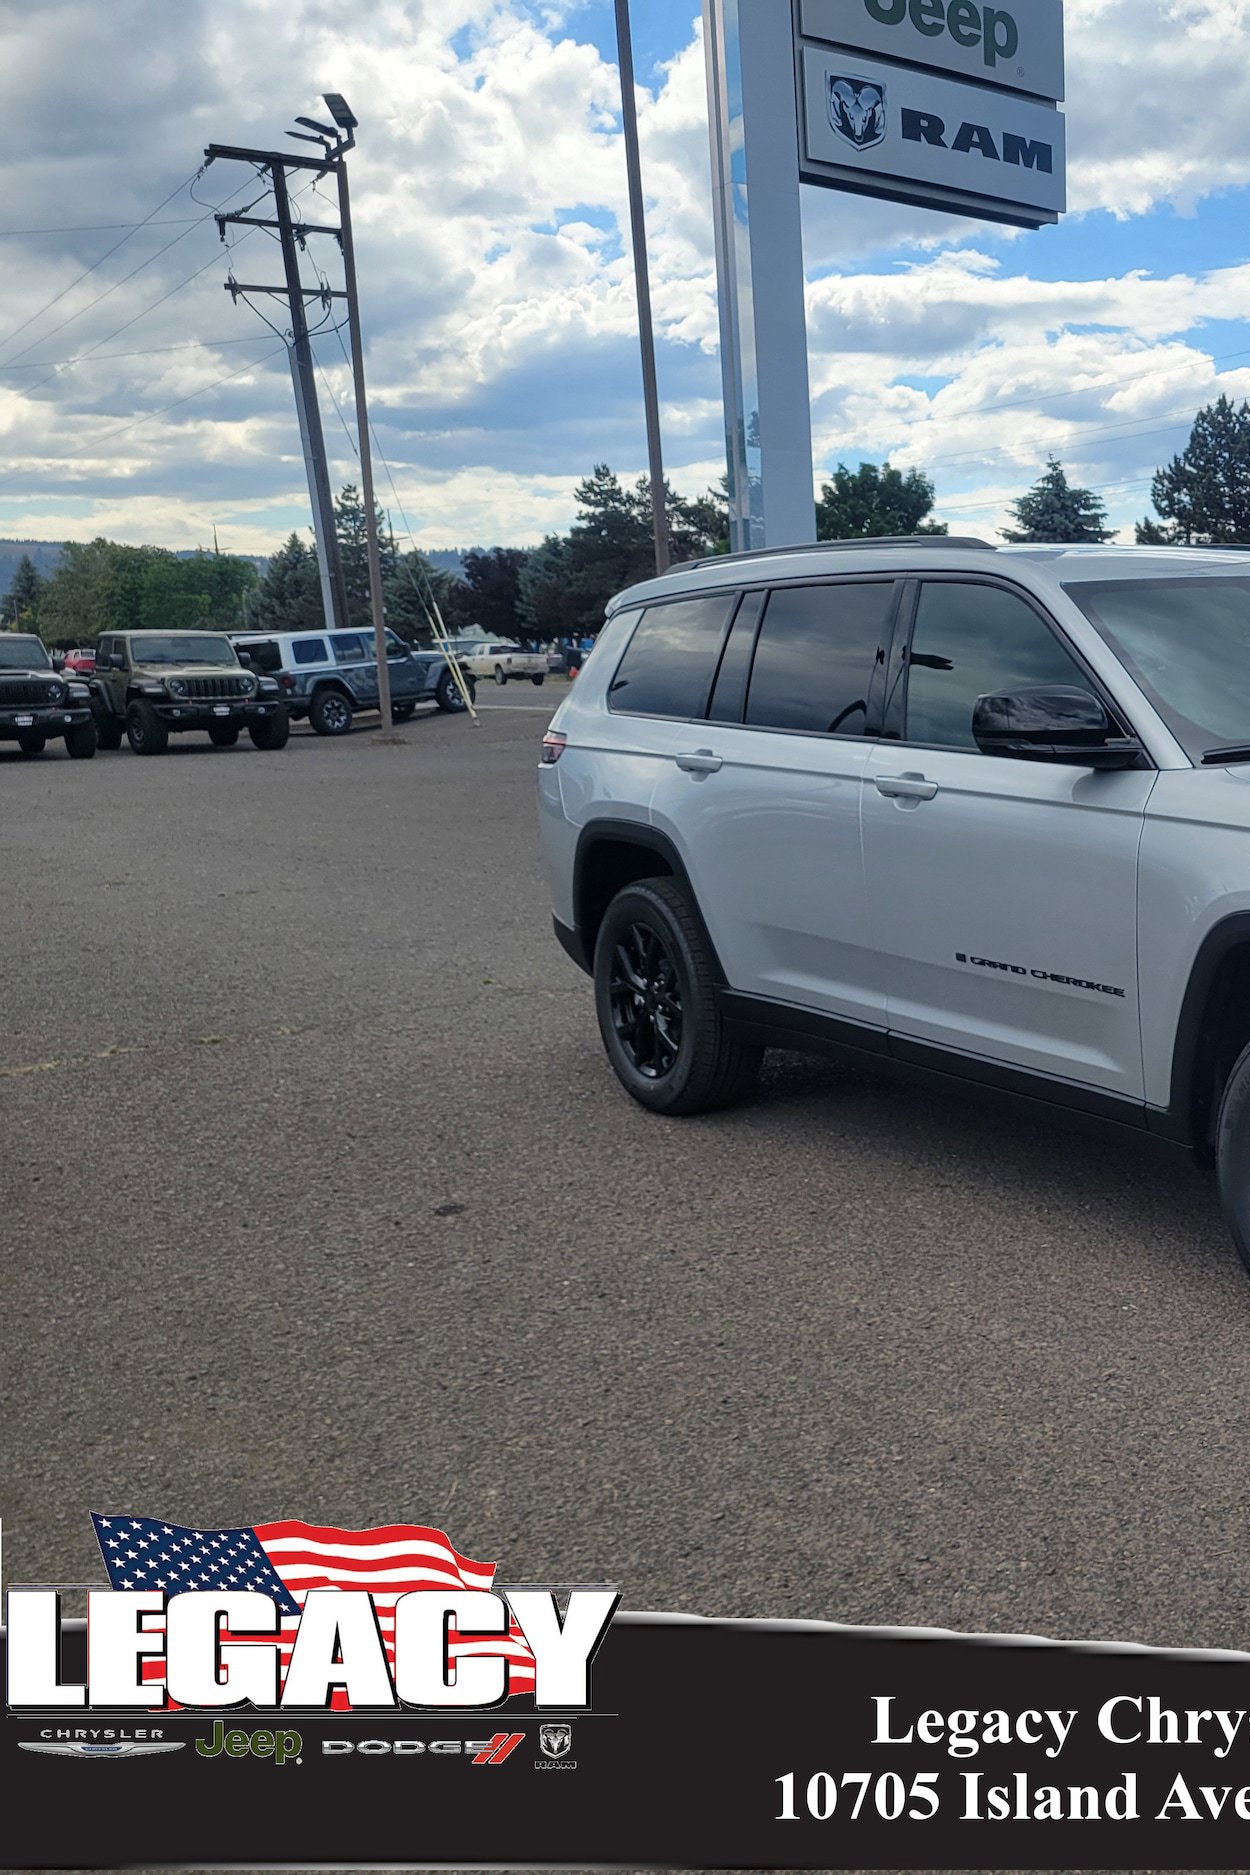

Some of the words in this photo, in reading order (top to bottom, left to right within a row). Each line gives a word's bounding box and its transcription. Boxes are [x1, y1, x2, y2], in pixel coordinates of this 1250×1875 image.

[900, 106, 1054, 174] RAM
[970, 956, 1027, 975] GRAND
[1030, 969, 1126, 997] CHEROKEE
